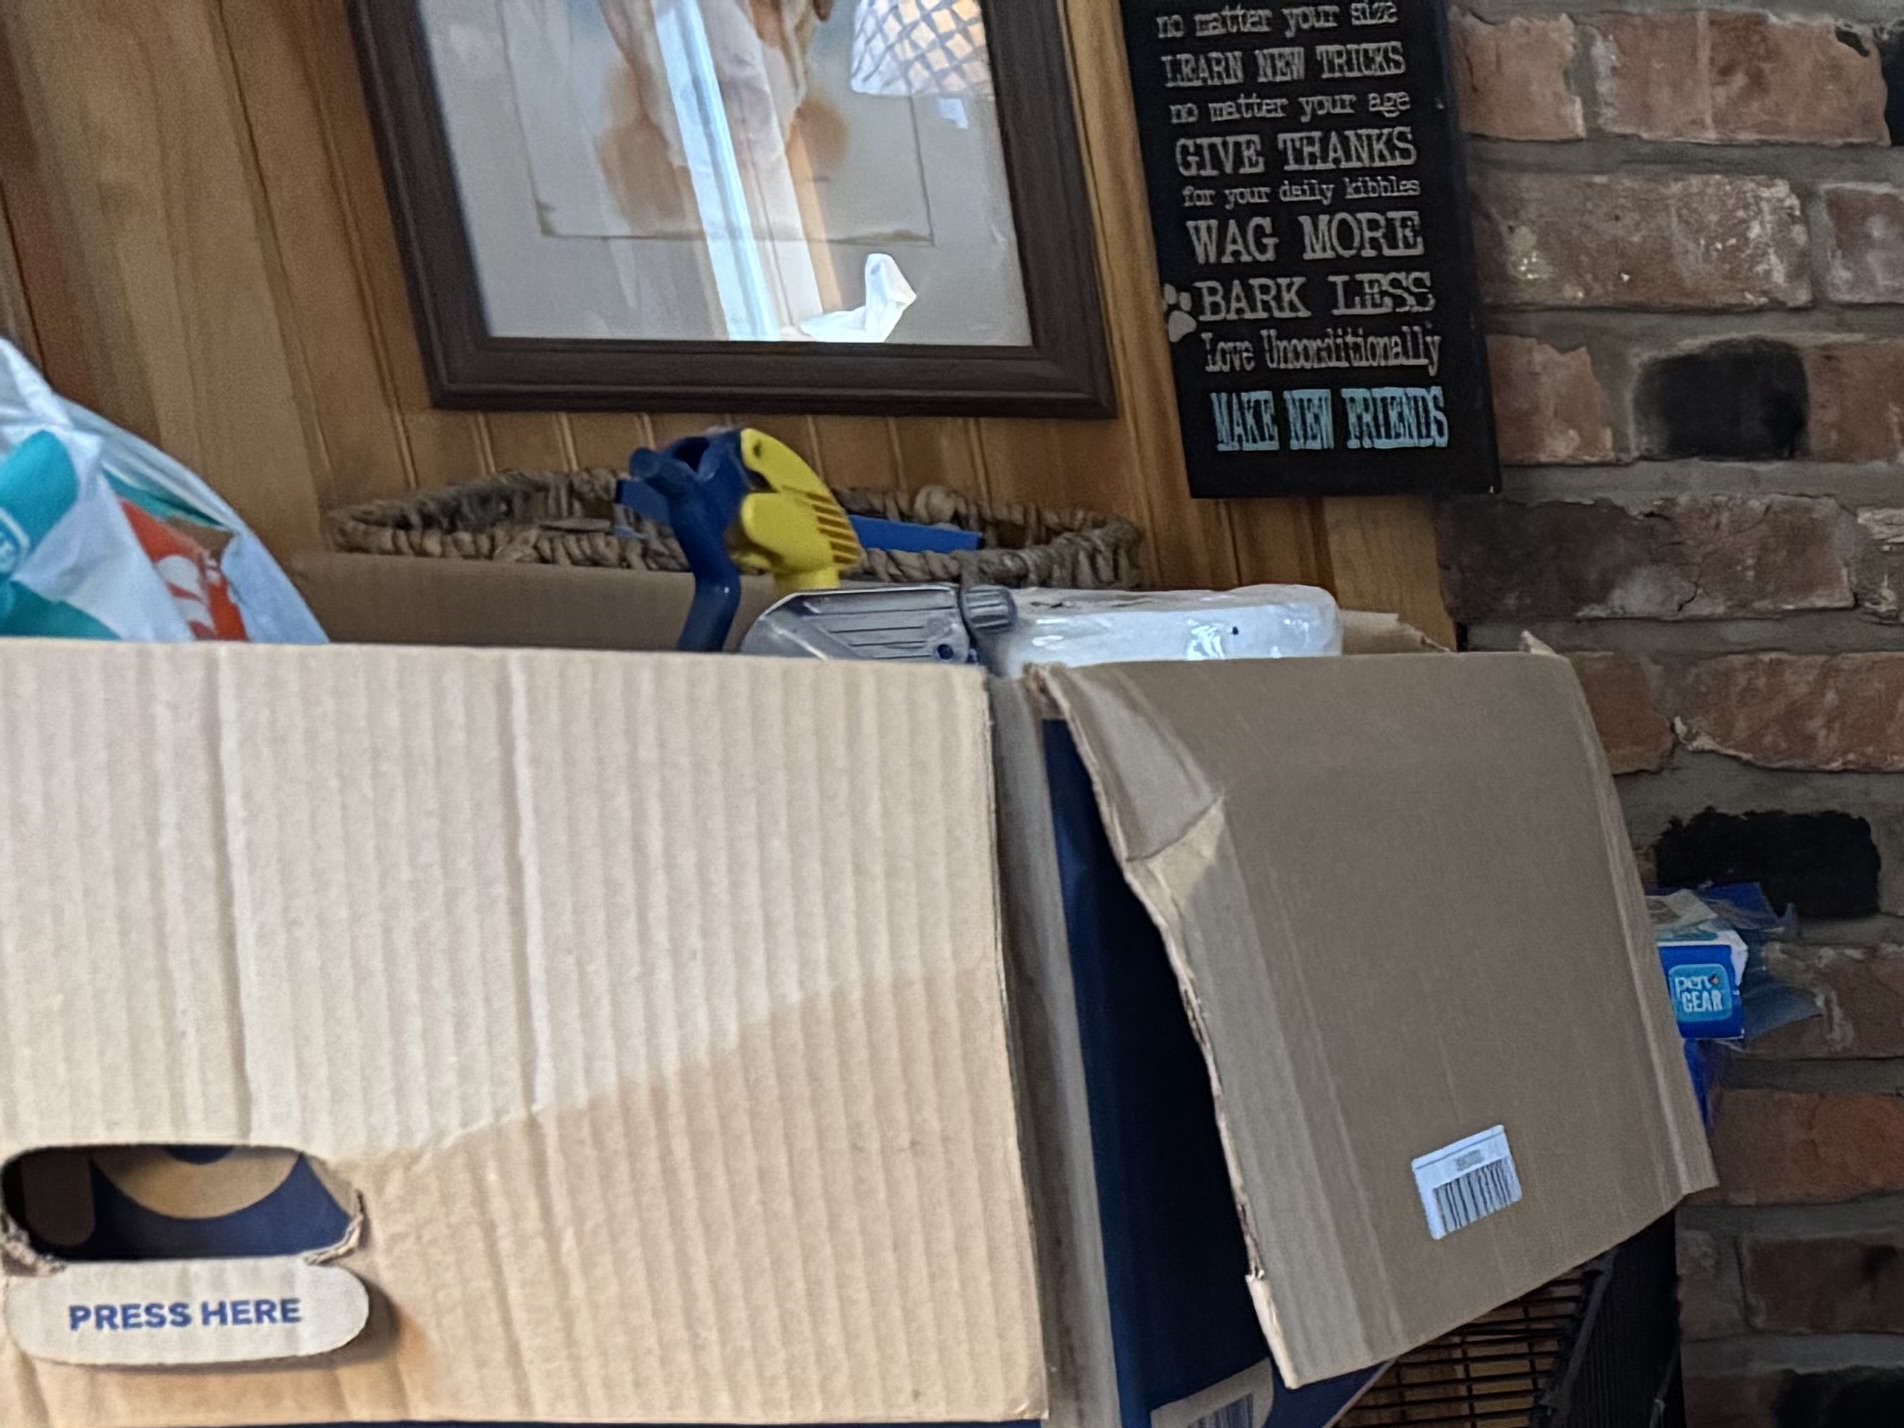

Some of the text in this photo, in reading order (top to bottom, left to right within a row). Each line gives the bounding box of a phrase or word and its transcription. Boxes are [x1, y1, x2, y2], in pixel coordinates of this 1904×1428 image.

[1156, 1, 1398, 39] no matter your size
[1160, 41, 1407, 88] LEARN NEW TRICKS
[1170, 91, 1411, 124] no matter your age
[1175, 126, 1417, 176] GIVE THANKS
[1182, 176, 1421, 210] for your daily kibbles
[1185, 211, 1424, 264] WAG MORE
[1193, 271, 1436, 322] BARK LESS
[1201, 325, 1442, 377] Love Unconditionally
[1210, 386, 1449, 452] MAKE NEW FRIENDS
[1681, 989, 1723, 1013] GEAR
[67, 1297, 303, 1331] PRESS HERE
